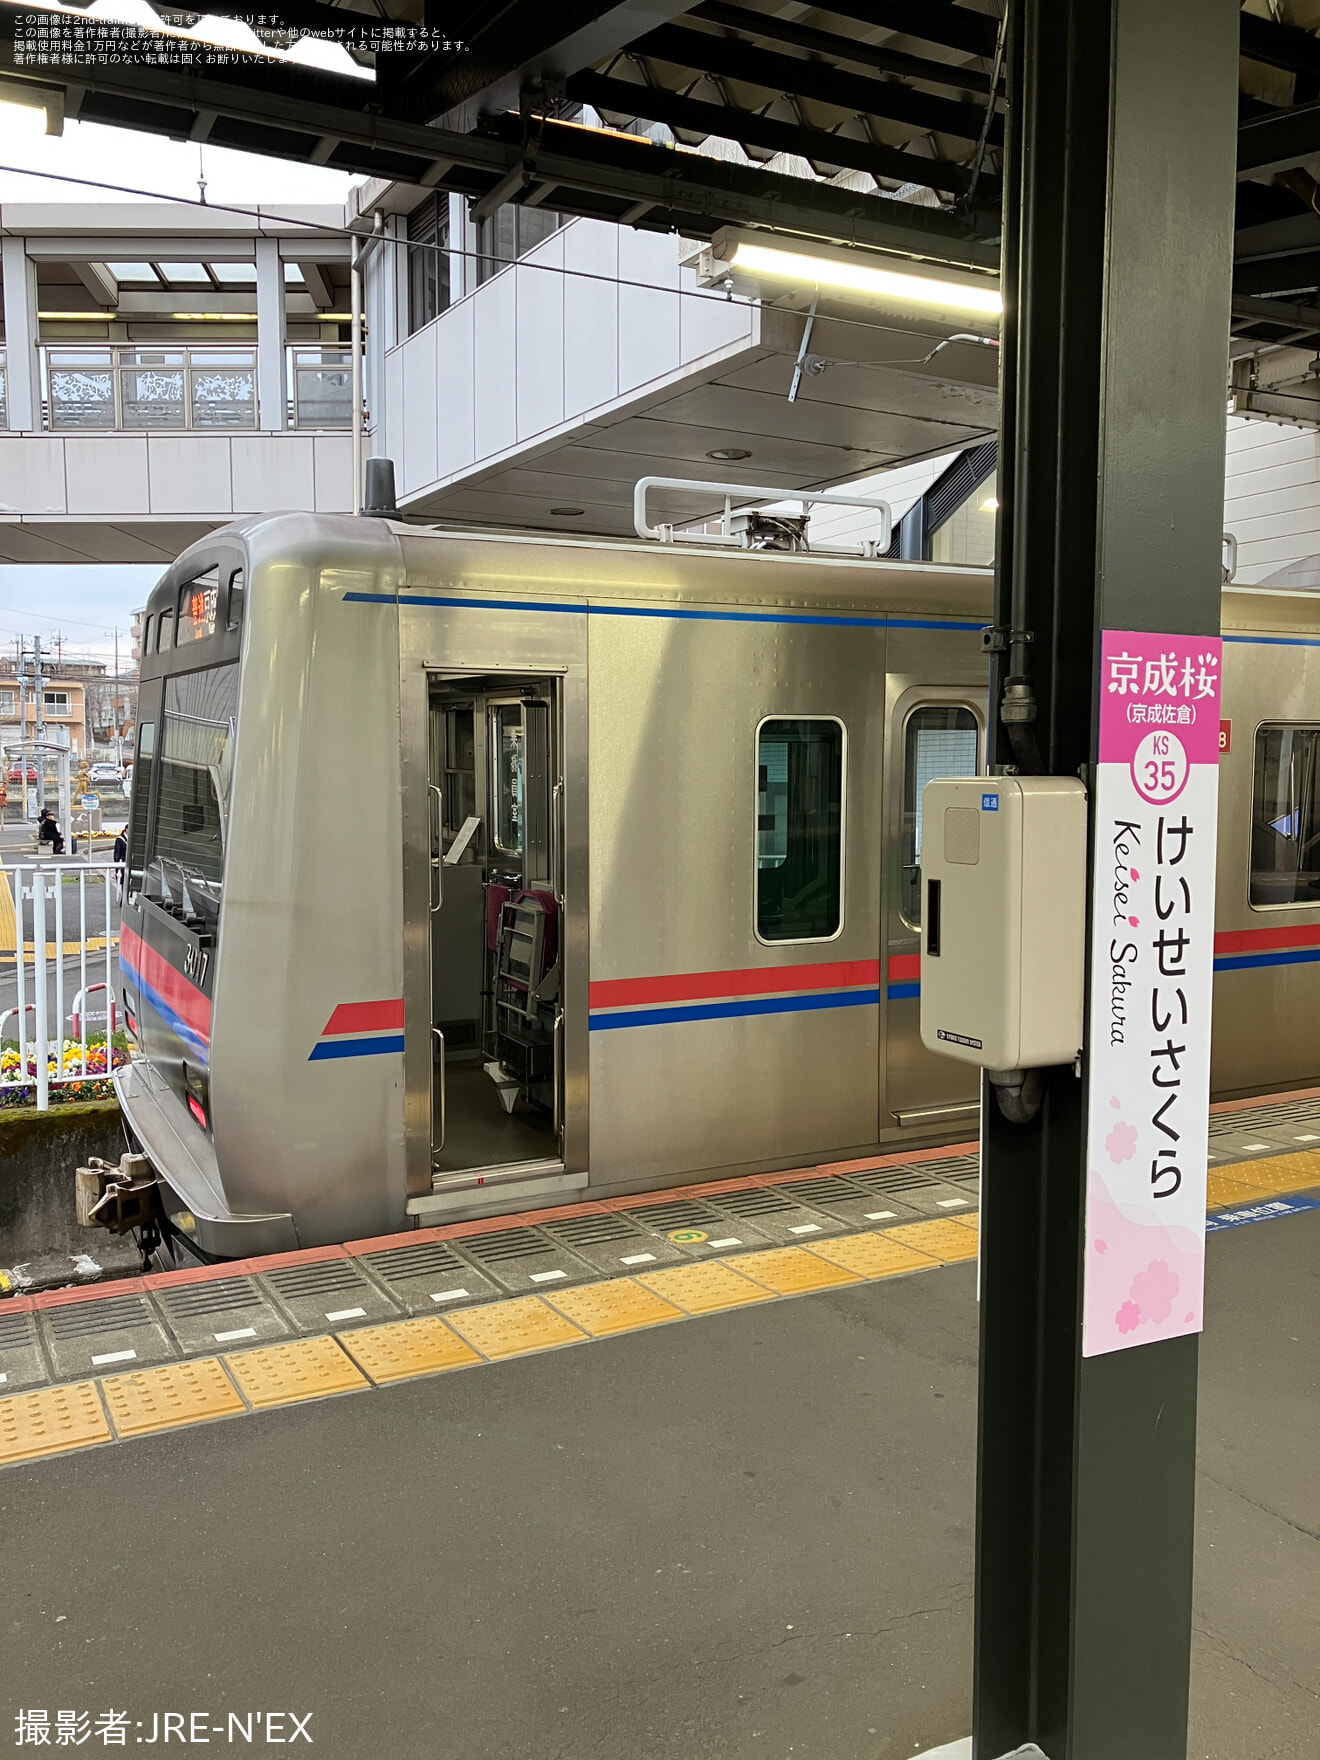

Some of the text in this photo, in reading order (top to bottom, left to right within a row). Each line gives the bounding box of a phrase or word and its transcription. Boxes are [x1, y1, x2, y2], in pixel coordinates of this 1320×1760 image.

[1107, 651, 1218, 700] 京成桜
[1126, 702, 1197, 725] (京成佐倉)
[1153, 735, 1169, 755] KS
[1144, 760, 1176, 791] 35
[1110, 820, 1141, 1047] Keisei Sakura
[1150, 816, 1193, 1199] けいせいさくら
